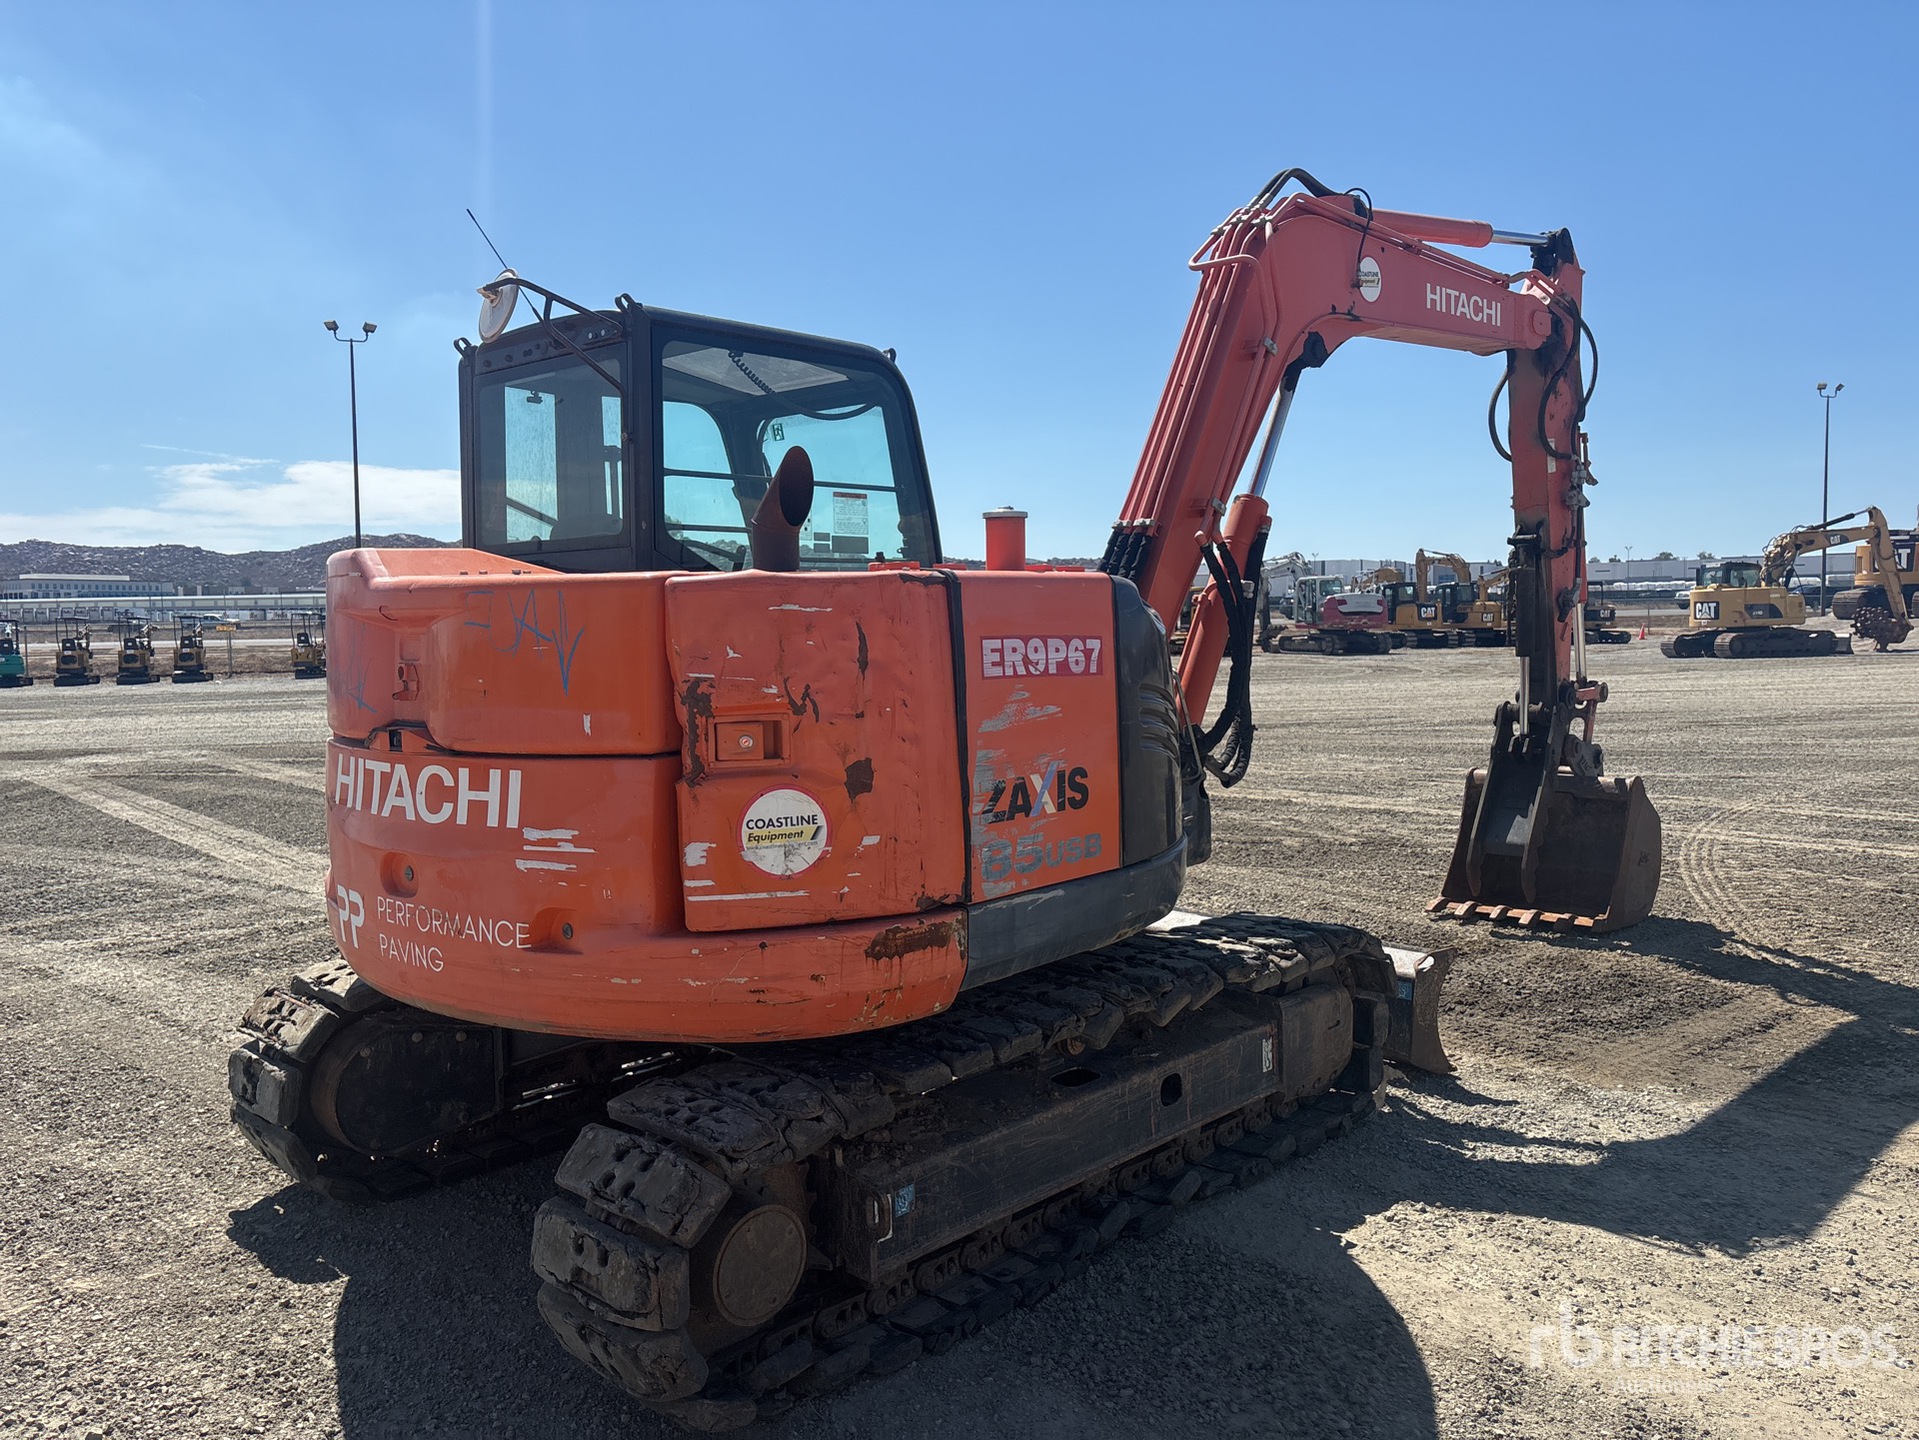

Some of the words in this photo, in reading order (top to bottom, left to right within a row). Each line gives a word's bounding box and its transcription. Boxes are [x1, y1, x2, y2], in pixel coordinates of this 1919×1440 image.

[1426, 283, 1500, 326] HITACHI
[1830, 535, 1841, 544] CAT
[1421, 607, 1436, 618] CAT
[1482, 613, 1494, 622] CAT
[1600, 609, 1611, 618] CAT
[1695, 602, 1717, 619] CAT
[982, 638, 1101, 678] ER9P67
[335, 753, 522, 829] HITACHI
[981, 761, 1090, 825] ZAXIS
[746, 814, 819, 830] COASTLINE
[747, 829, 805, 844] Equipment
[377, 896, 532, 949] PERFORMANCE
[379, 933, 444, 972] PAVING
